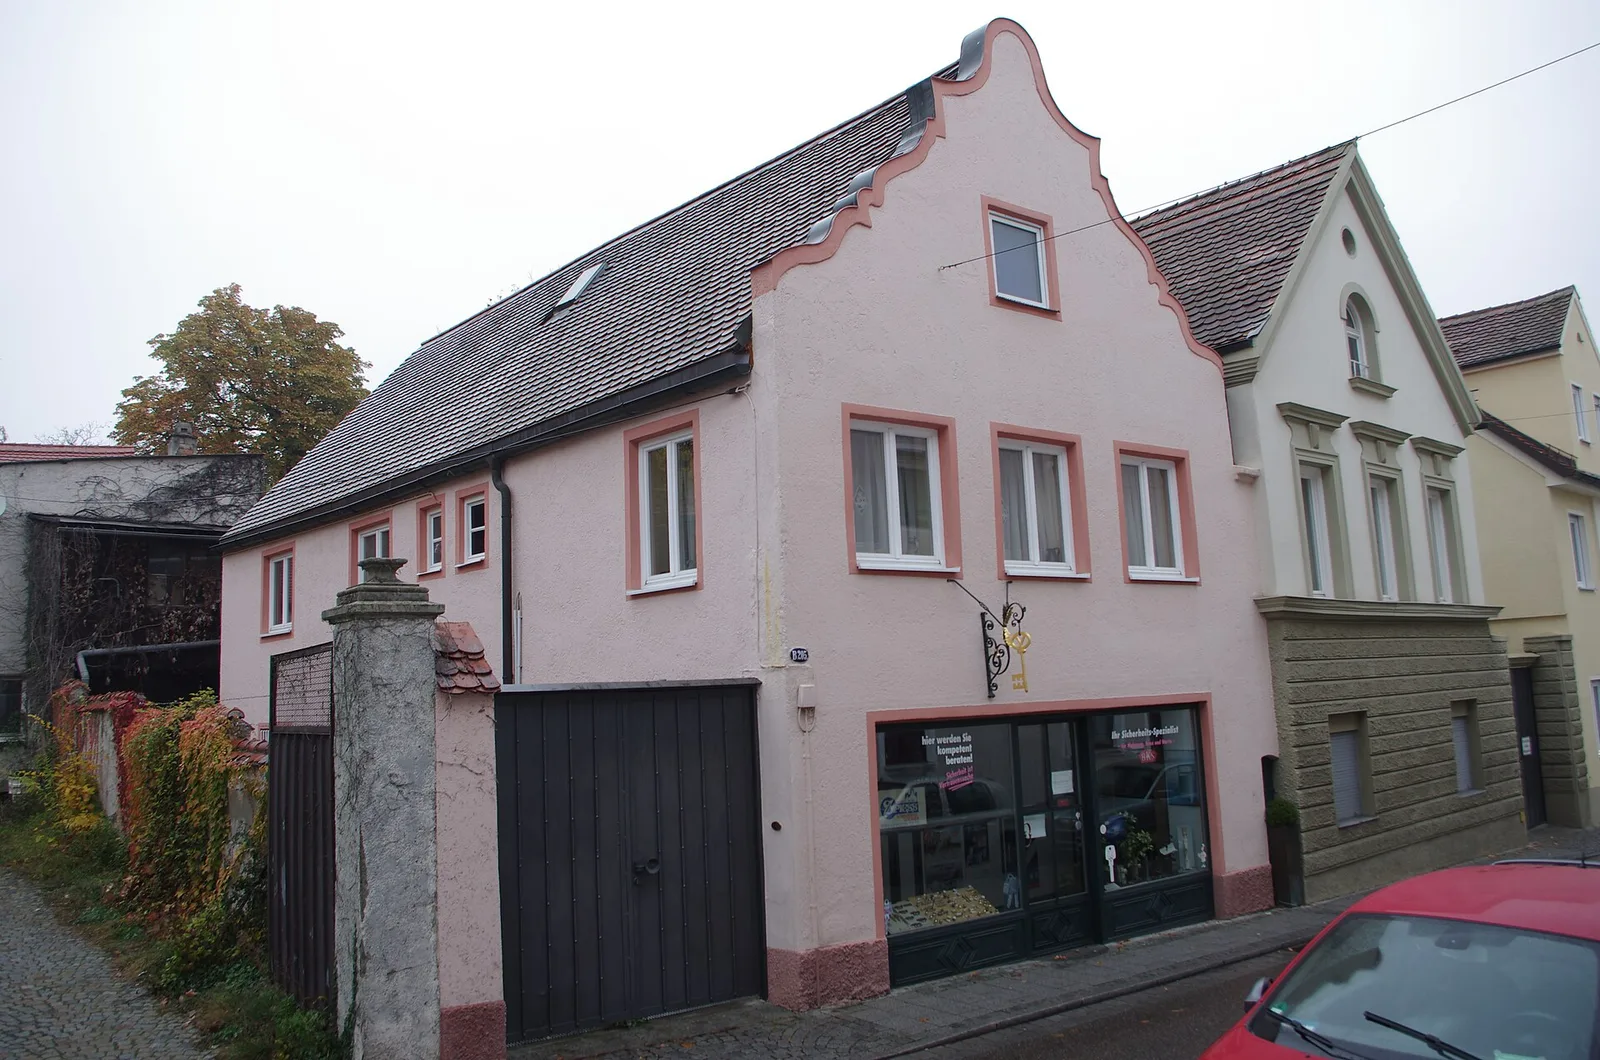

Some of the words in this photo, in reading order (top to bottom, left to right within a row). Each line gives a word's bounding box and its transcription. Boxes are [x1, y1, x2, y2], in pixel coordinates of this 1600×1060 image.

[921, 735, 936, 746] hier
[936, 733, 961, 745] werden
[962, 732, 972, 743] Sie
[1111, 730, 1120, 740] Ihr
[1121, 725, 1179, 739] Sicherheits-Spezialist
[937, 744, 973, 757] kompetent
[945, 753, 973, 765] beraten!
